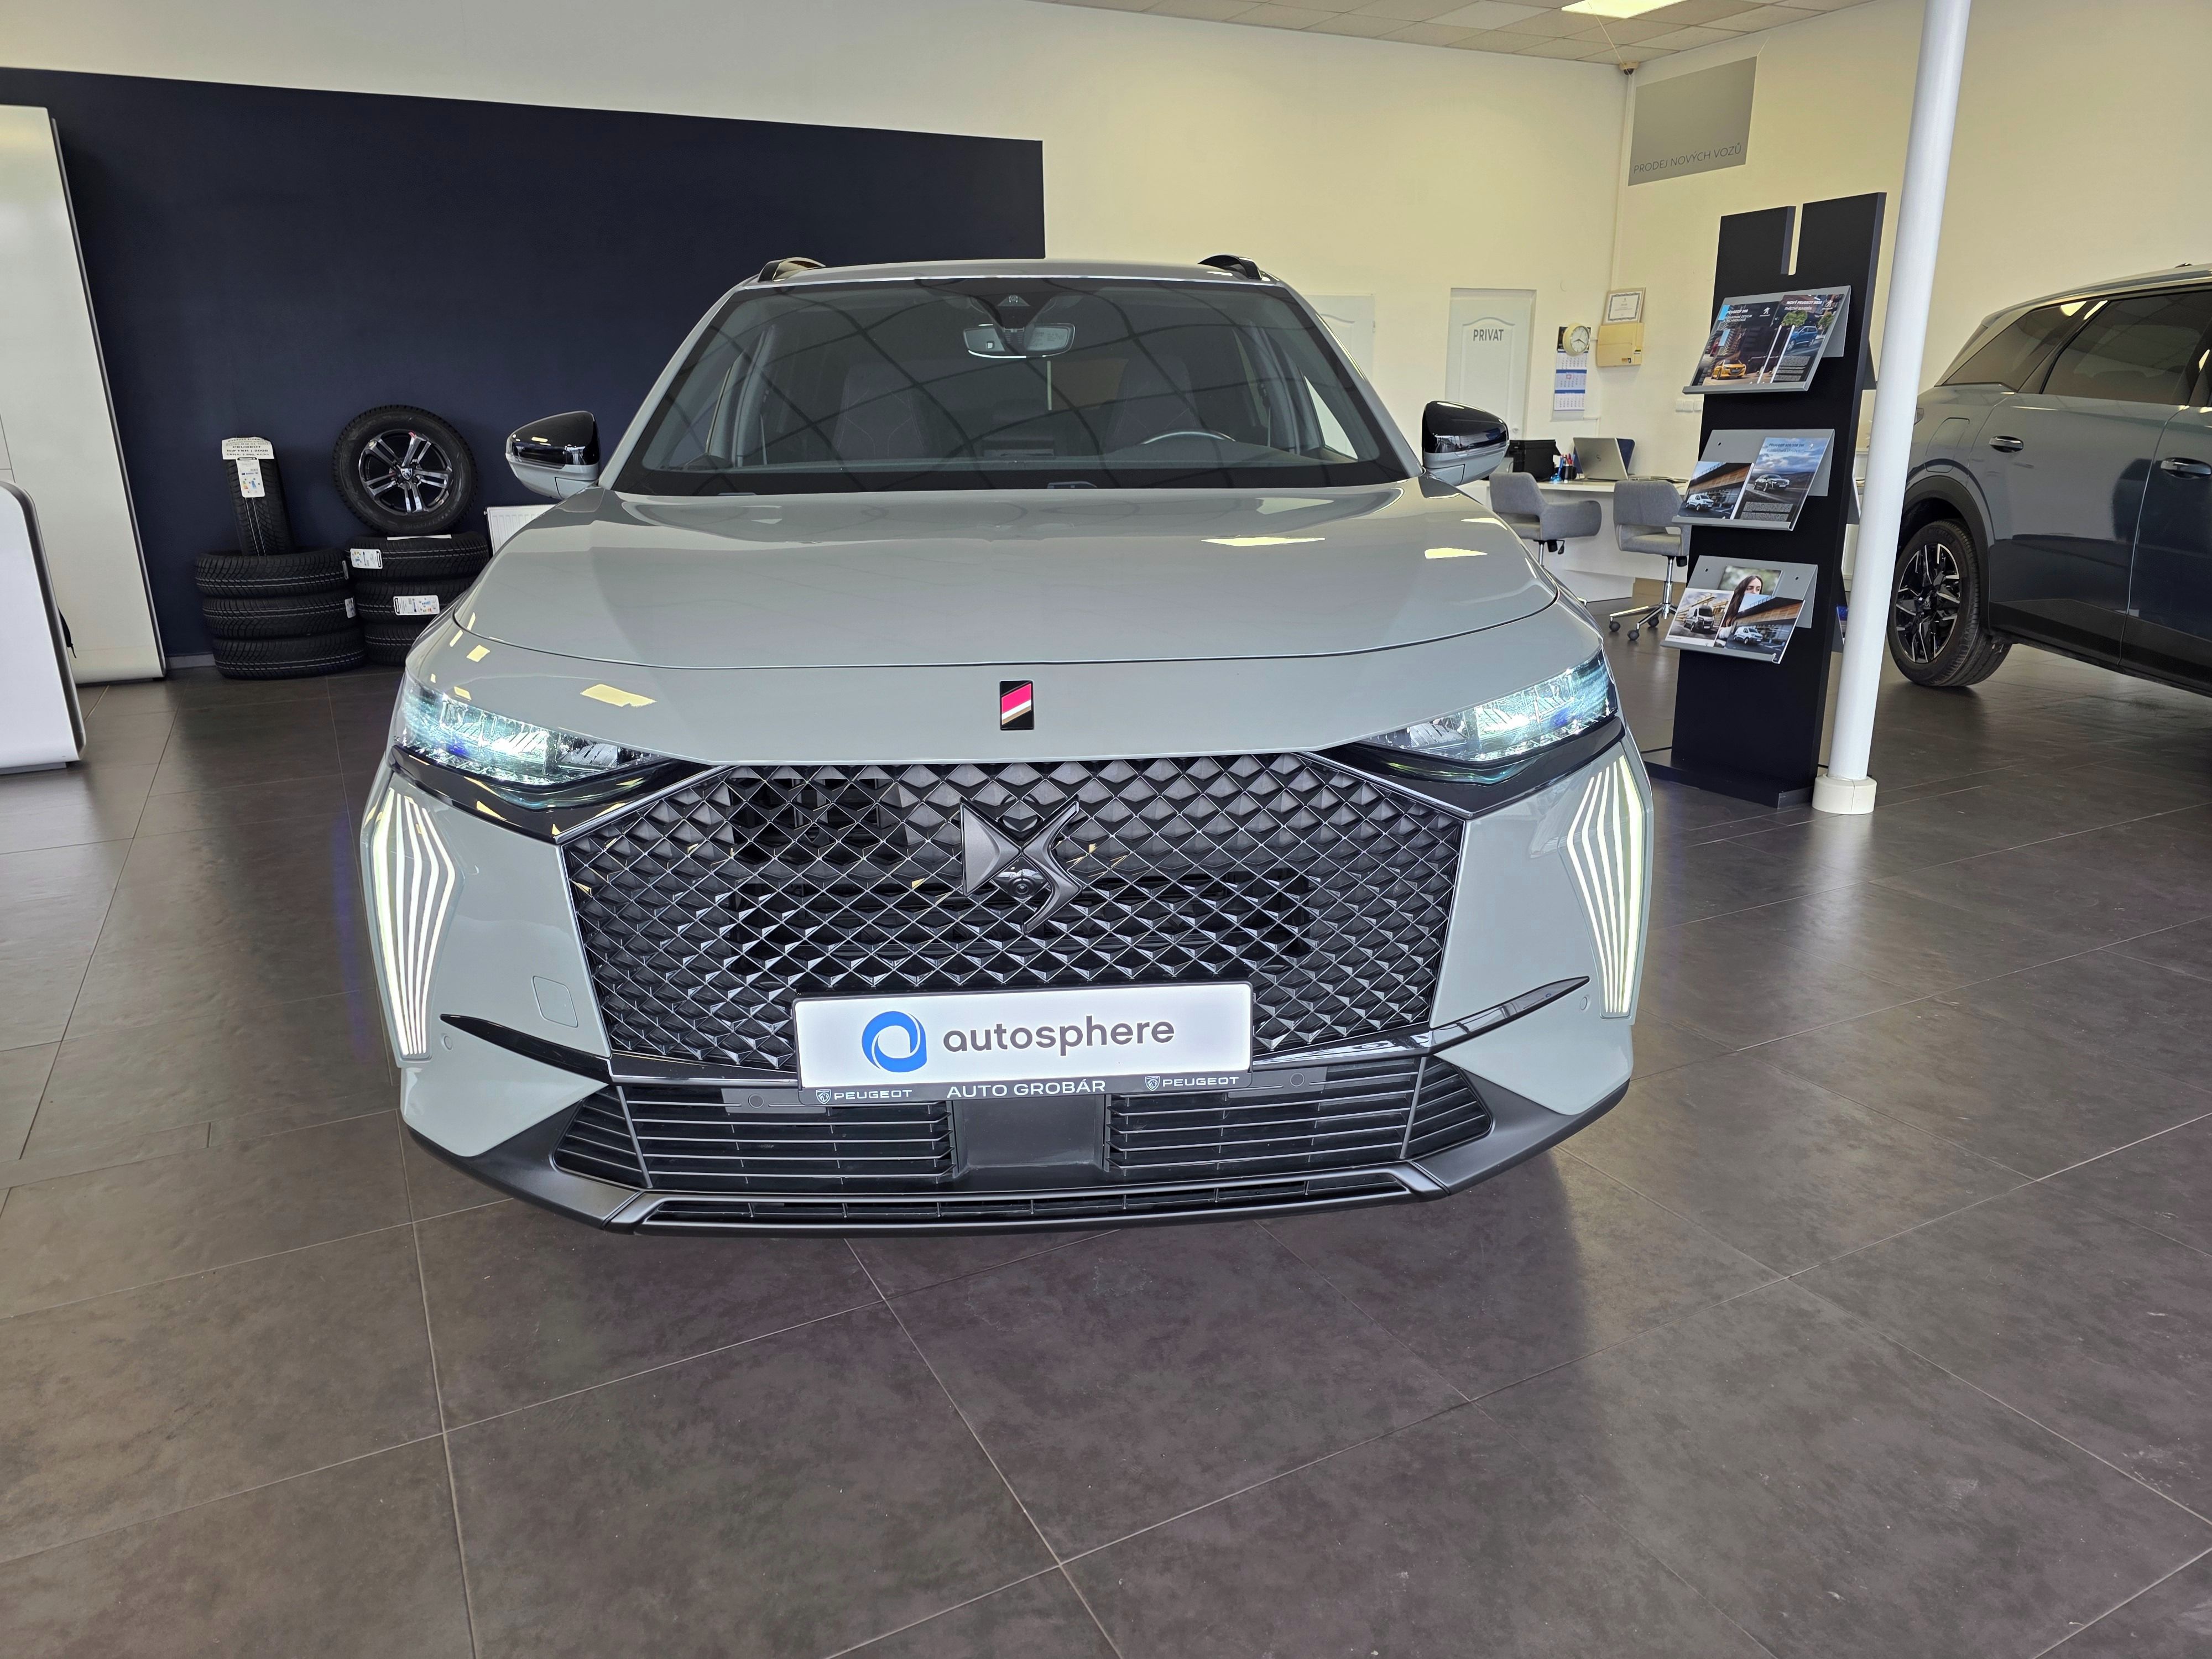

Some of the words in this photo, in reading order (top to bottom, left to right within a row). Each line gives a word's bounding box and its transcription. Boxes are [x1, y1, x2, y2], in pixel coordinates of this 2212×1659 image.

[1634, 159, 1668, 174] PRODEJ
[1670, 151, 1711, 166] NOVÝCH
[1714, 142, 1741, 158] VOZŮ
[1473, 328, 1504, 342] PRIVAT
[943, 1015, 1175, 1056] autosphere
[946, 1084, 1008, 1098] AUTO
[1014, 1078, 1105, 1095] GROBÁR
[1162, 1077, 1239, 1087] PEUGEOT
[834, 1089, 912, 1100] PEUGEOT
